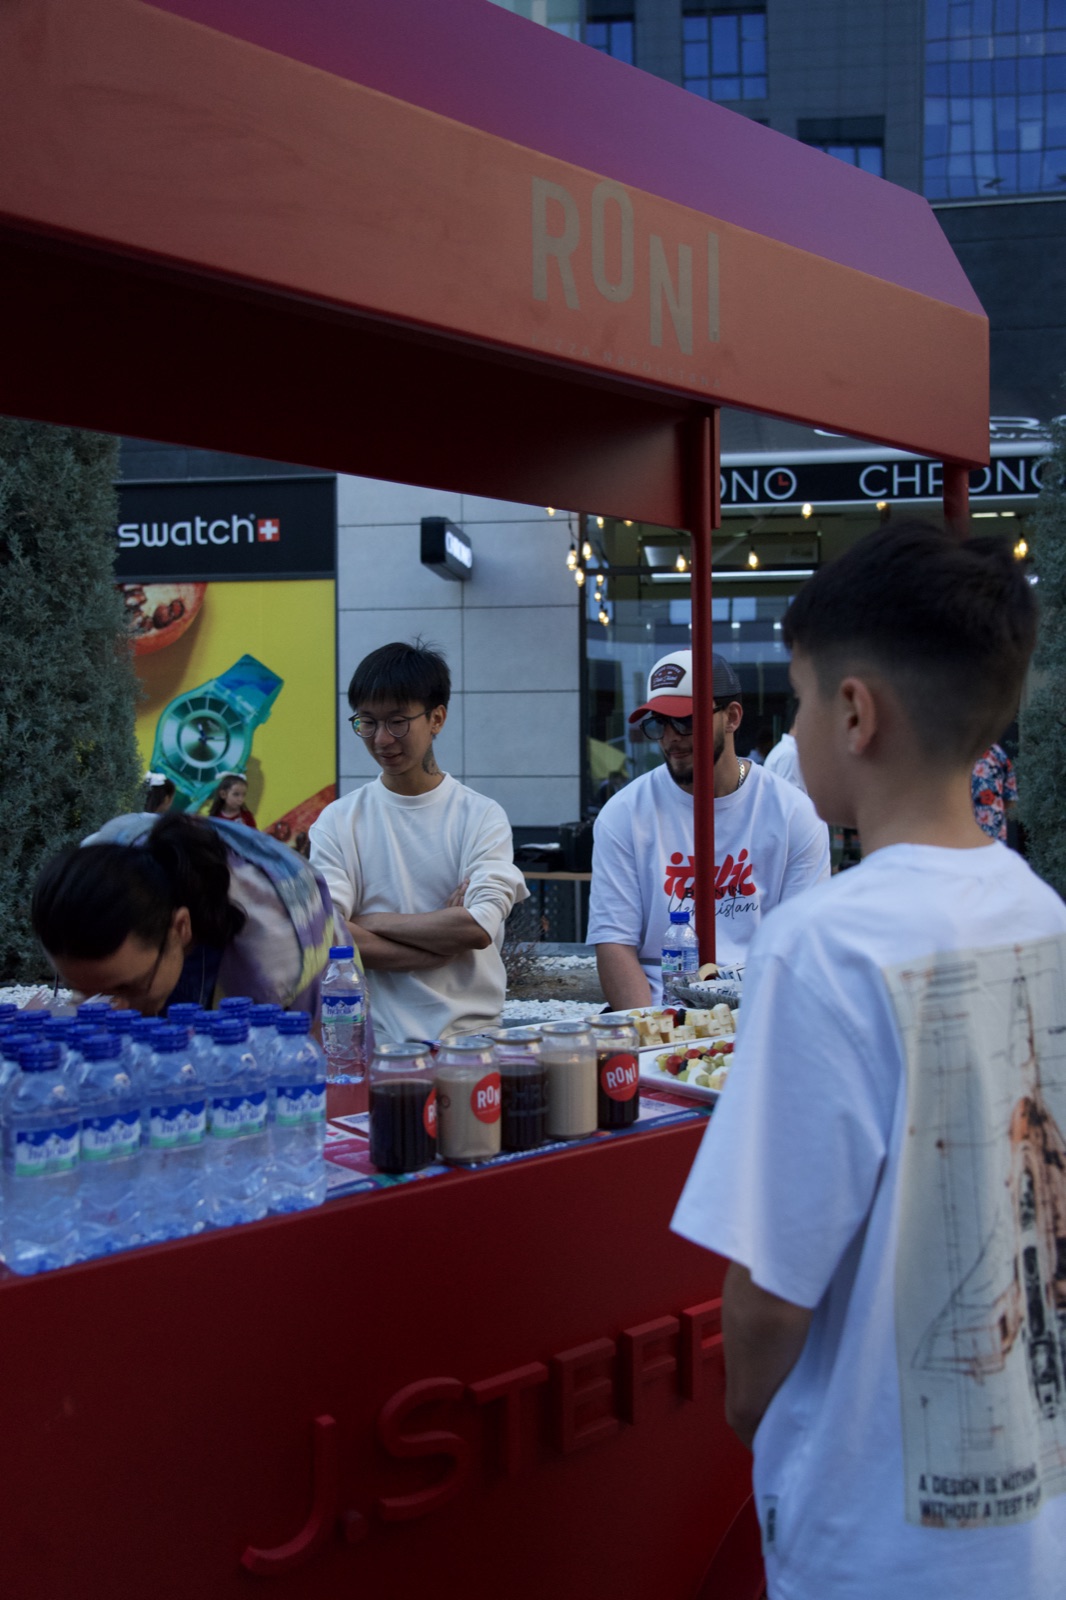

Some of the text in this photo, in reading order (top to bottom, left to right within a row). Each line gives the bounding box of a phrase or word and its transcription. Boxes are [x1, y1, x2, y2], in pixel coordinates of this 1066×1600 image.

[531, 175, 720, 357] RONI
[117, 514, 255, 548] swatch
[664, 848, 757, 901] itlic
[605, 1063, 637, 1089] RONI
[931, 1475, 980, 1496] DESIGN
